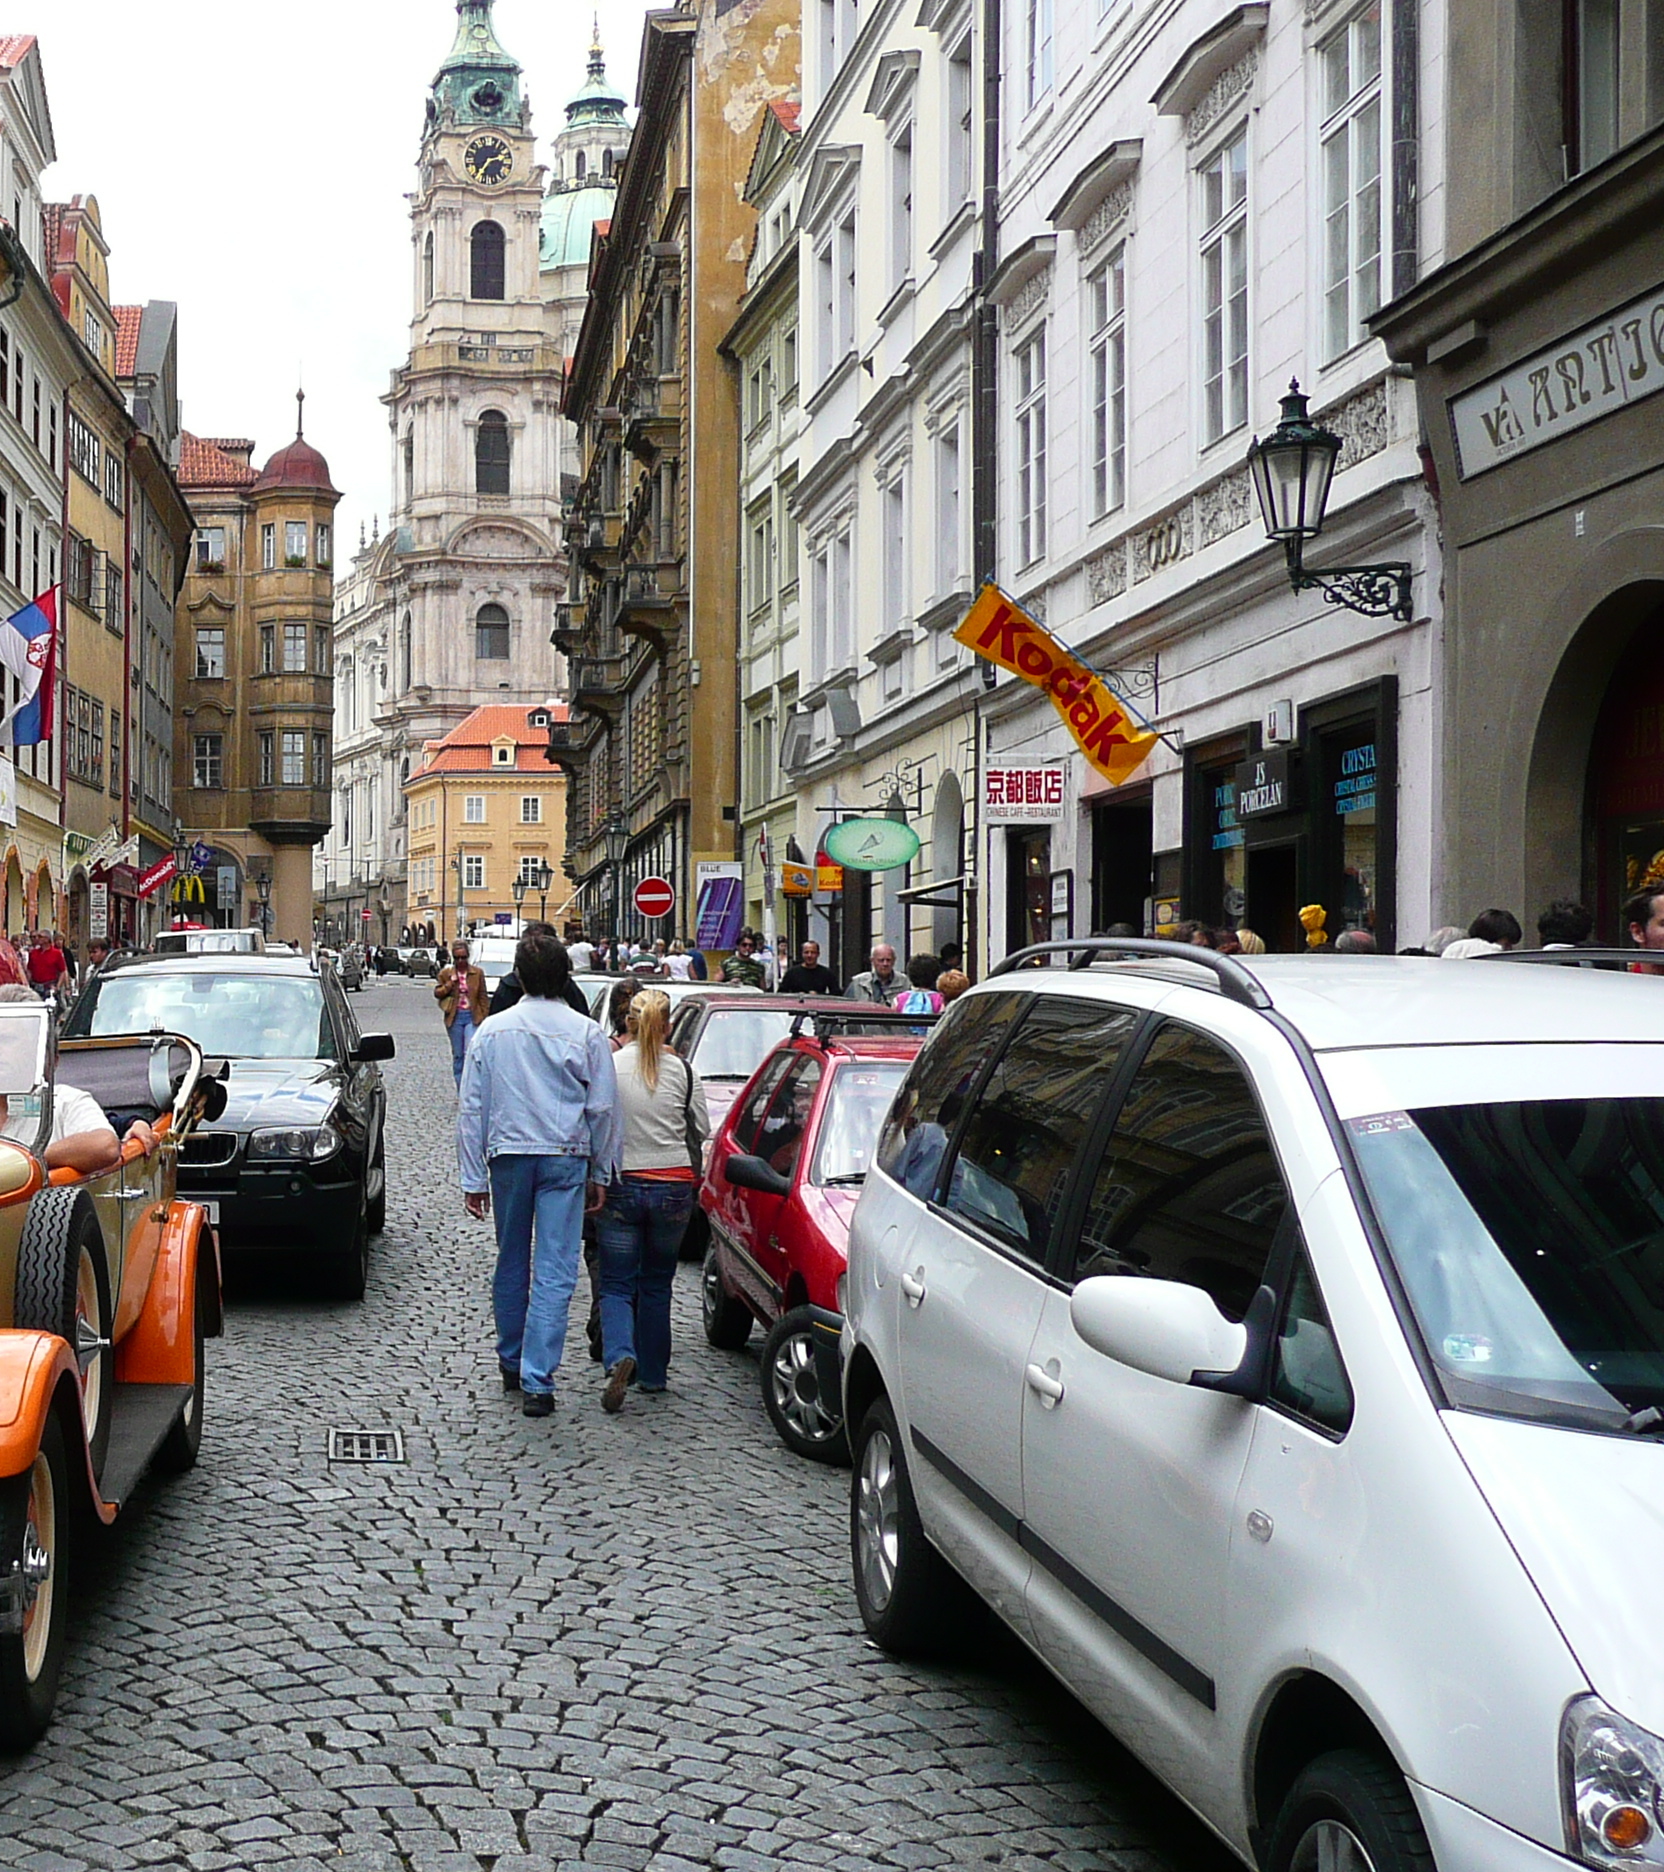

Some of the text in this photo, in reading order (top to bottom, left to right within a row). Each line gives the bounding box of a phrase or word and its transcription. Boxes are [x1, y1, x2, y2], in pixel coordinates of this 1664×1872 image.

[976, 604, 1129, 767] Kodak
[986, 769, 1062, 805] 京都飯店
[1240, 779, 1283, 815] PORCELÁN
